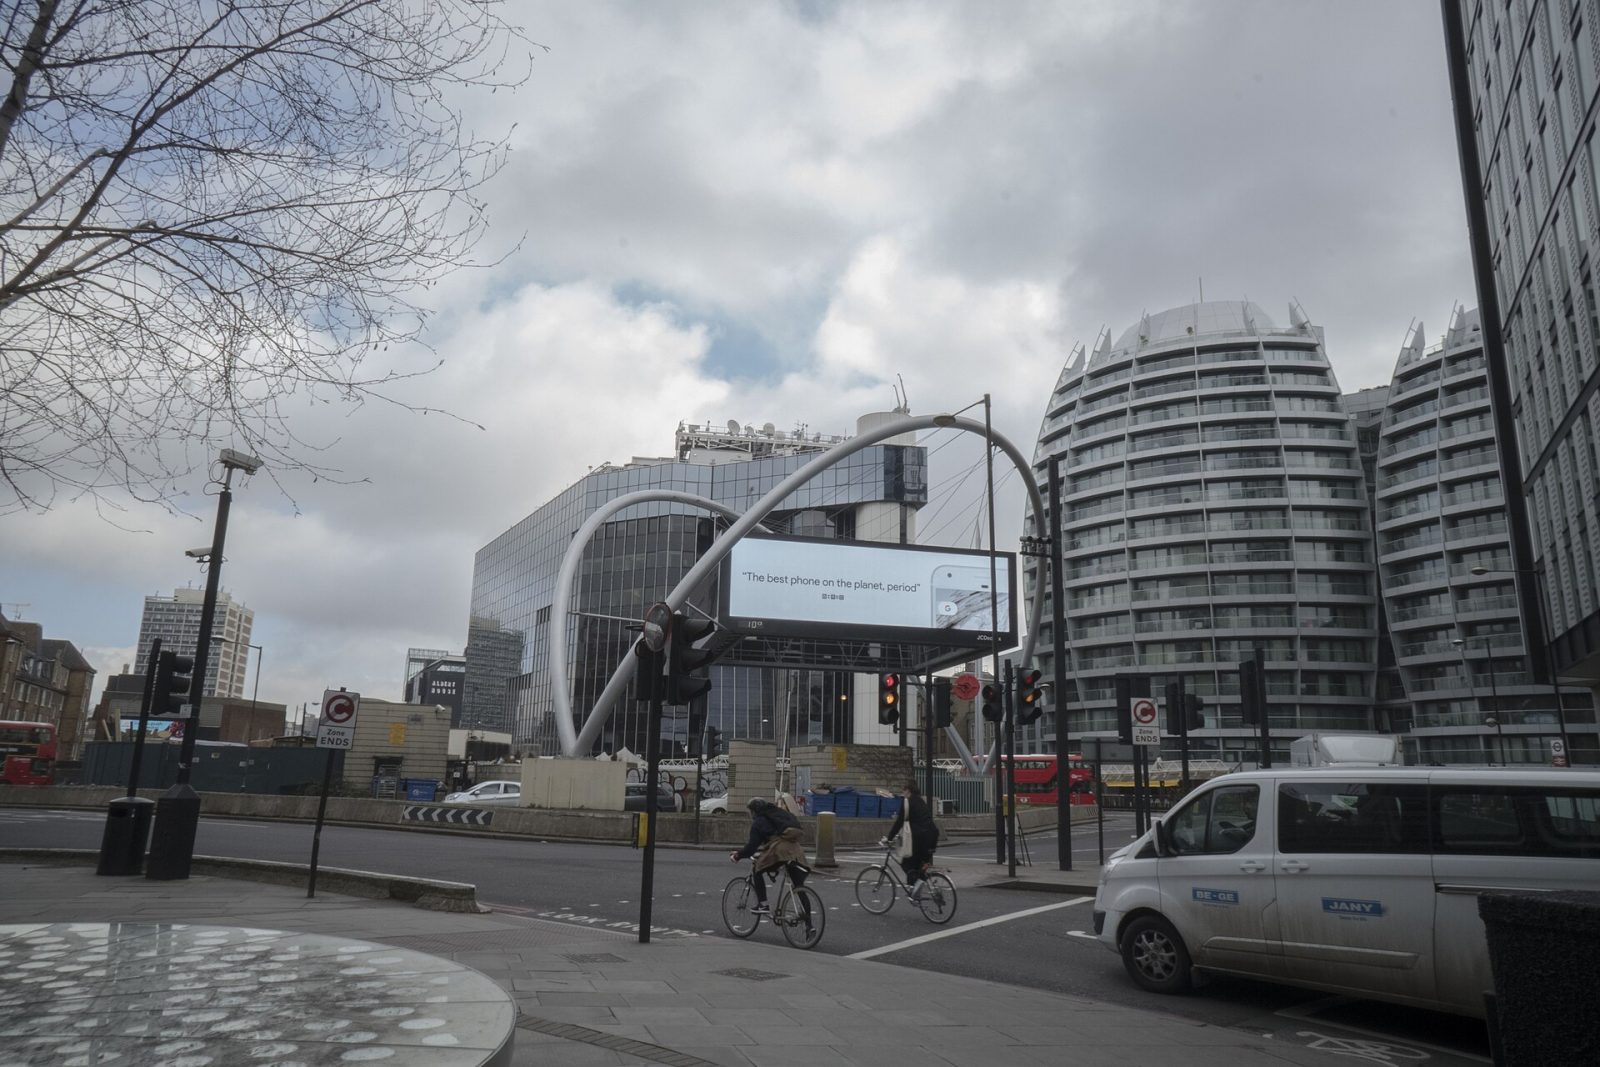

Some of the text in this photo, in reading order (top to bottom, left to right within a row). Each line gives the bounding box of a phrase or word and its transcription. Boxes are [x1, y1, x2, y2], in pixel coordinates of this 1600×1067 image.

[767, 573, 788, 584] best
[790, 576, 820, 586] phone
[822, 579, 834, 587] on
[836, 578, 852, 588] the
[854, 580, 885, 591] planet,
[327, 728, 345, 736] Zone
[320, 736, 350, 747] ENDS
[1135, 735, 1158, 743] ENDS
[1329, 901, 1373, 912] JANY
[537, 911, 607, 924] LOOK
